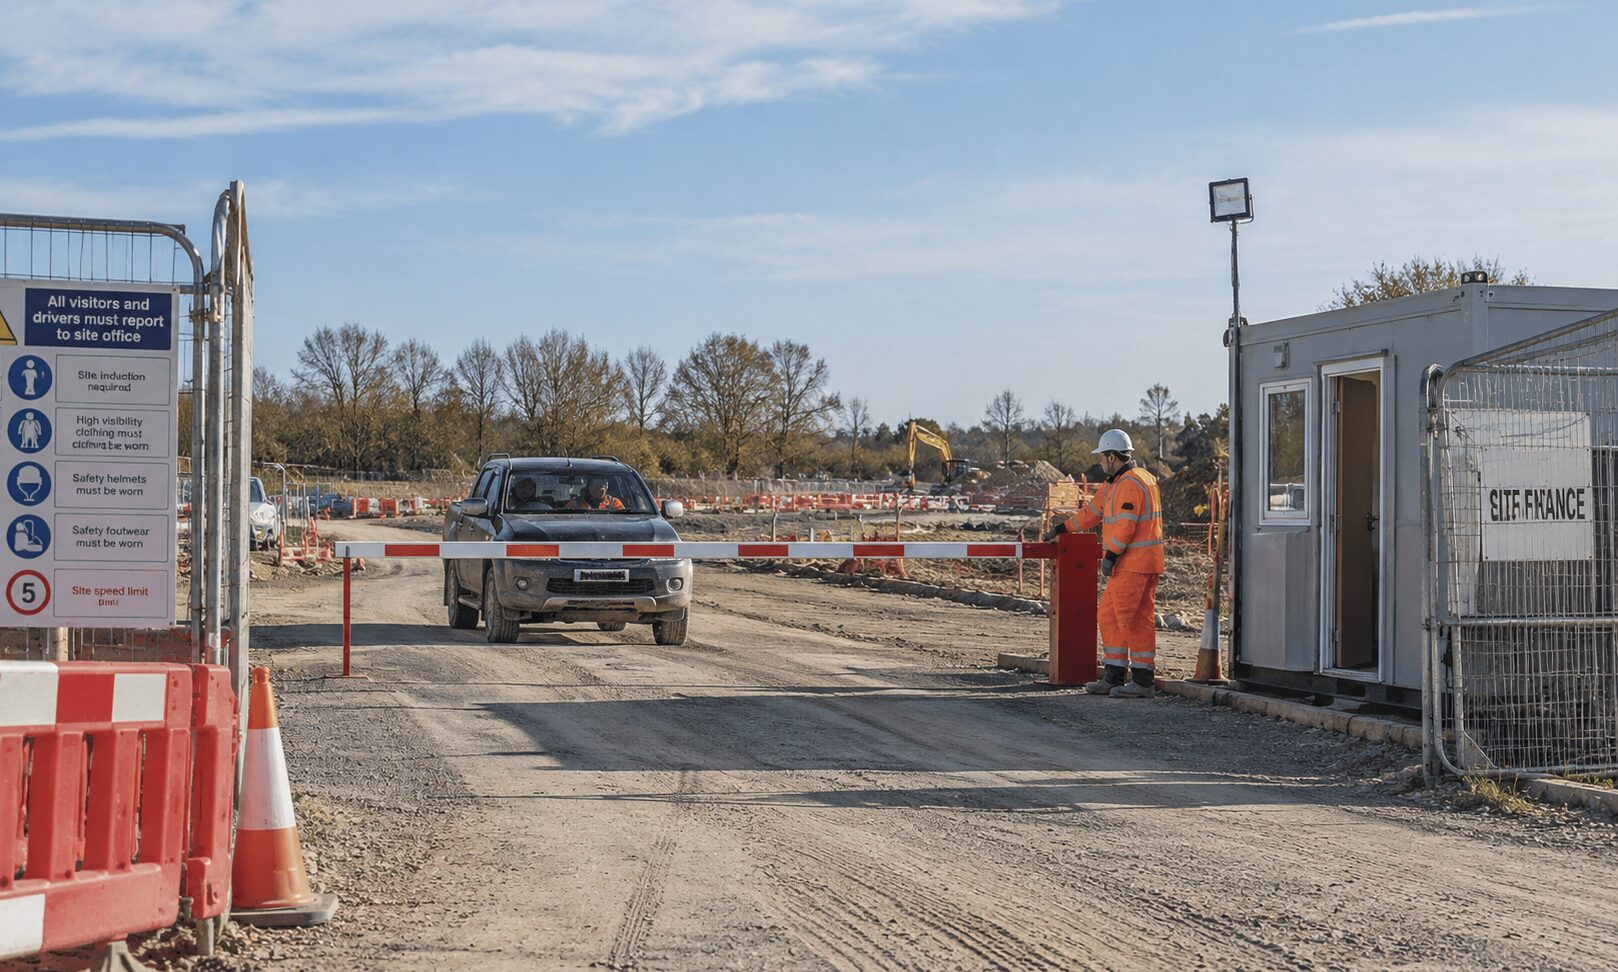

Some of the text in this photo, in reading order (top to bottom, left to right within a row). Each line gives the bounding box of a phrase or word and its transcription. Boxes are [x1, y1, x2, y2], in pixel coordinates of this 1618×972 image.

[47, 295, 150, 311] All visitors and
[32, 311, 165, 330] drivers must report
[56, 328, 142, 343] to site office
[76, 415, 143, 428] High visibility
[72, 473, 147, 485] Safety helmets
[76, 486, 144, 496] must be worn
[72, 525, 104, 537] Safety
[76, 538, 144, 548] must be worn
[22, 582, 36, 603] 5
[72, 585, 149, 597] Site speed limit
